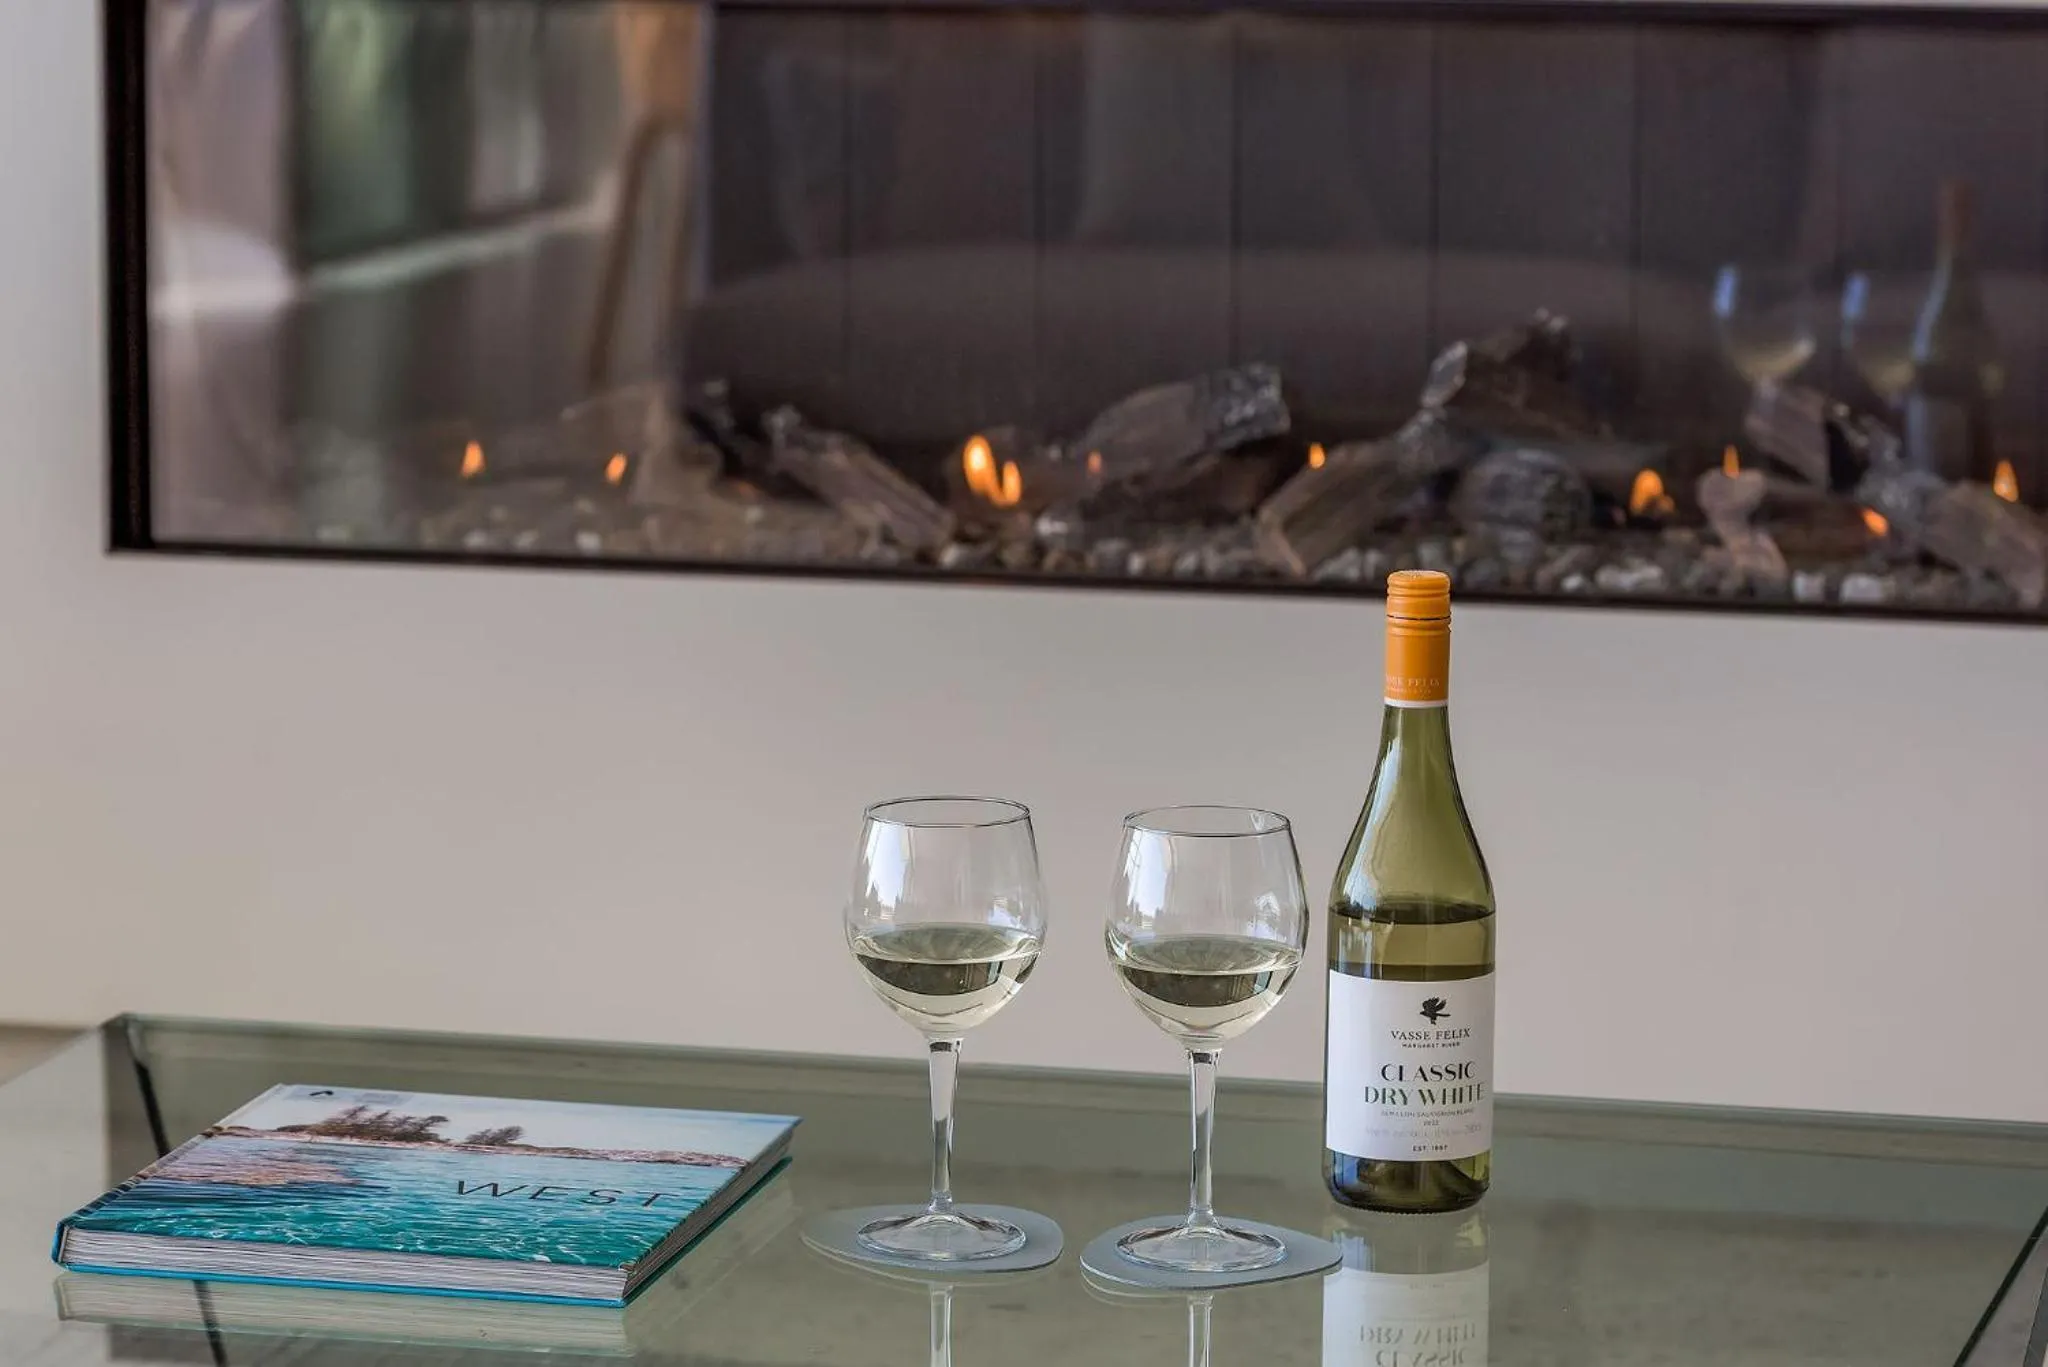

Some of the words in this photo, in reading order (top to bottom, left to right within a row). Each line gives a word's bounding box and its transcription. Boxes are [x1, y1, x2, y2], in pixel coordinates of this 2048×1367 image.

[1391, 1030, 1430, 1041] VASSE
[1435, 1027, 1471, 1040] FELIX
[1381, 1060, 1476, 1082] CLASSIC
[1364, 1086, 1413, 1106] DRY
[1418, 1082, 1486, 1106] WHITE
[457, 1180, 682, 1207] WEST
